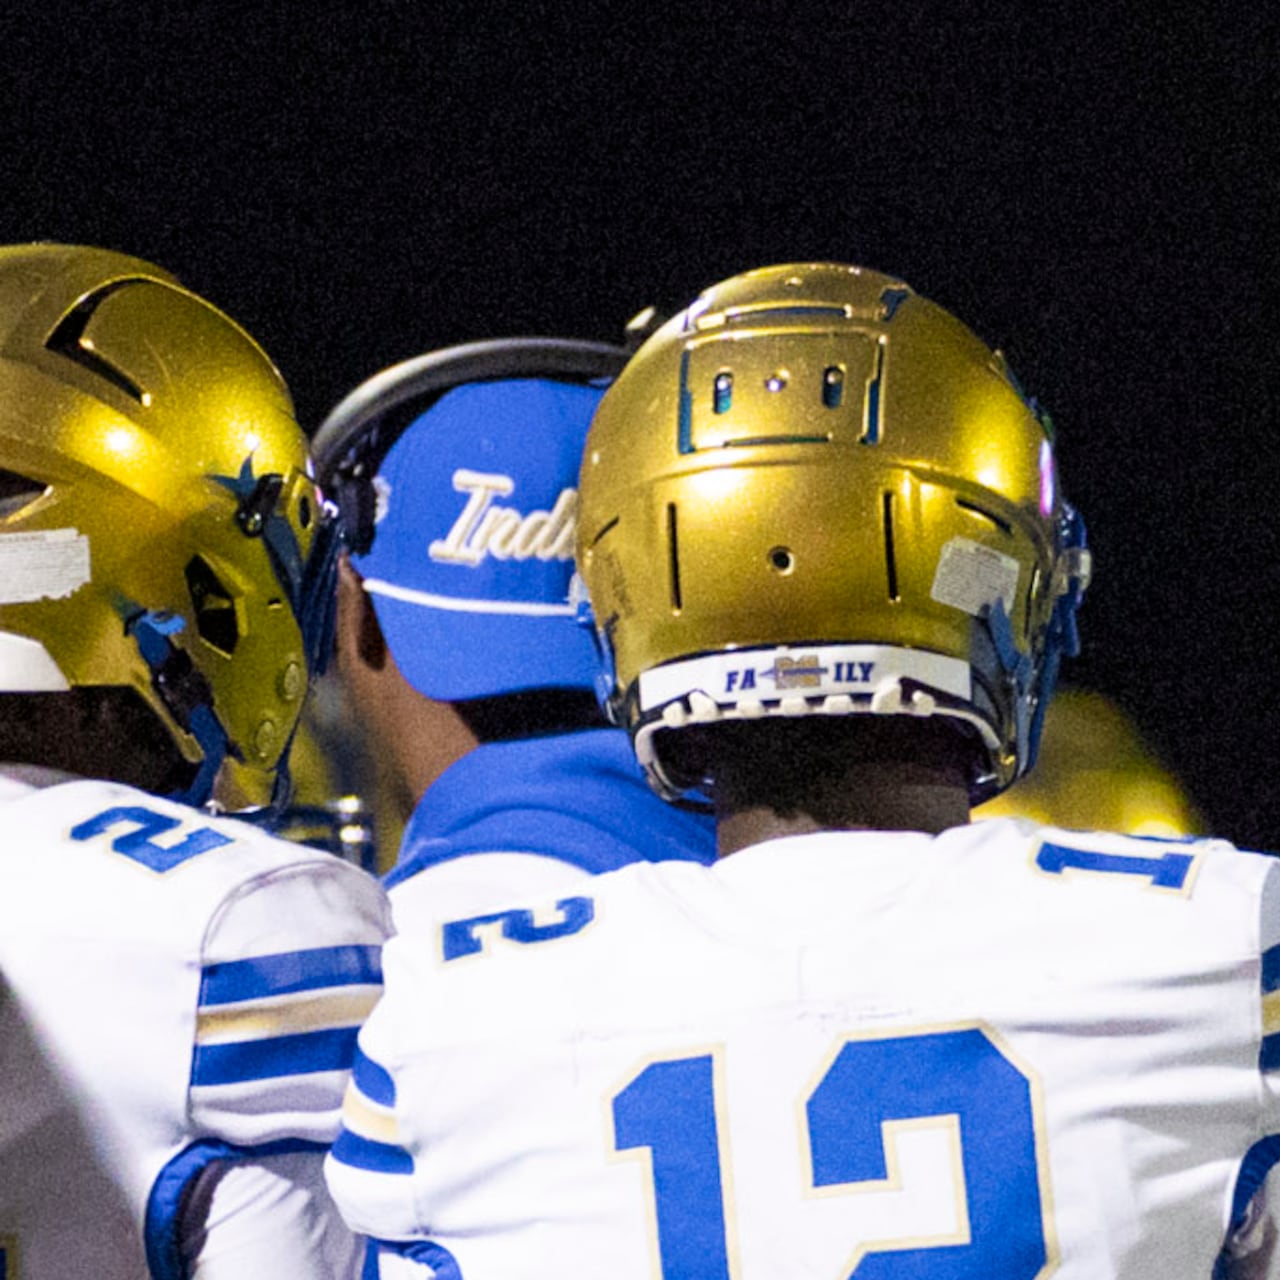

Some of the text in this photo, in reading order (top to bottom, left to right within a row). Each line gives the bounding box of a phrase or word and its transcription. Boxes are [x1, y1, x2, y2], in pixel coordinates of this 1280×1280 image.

[67, 802, 238, 877] 2
[1030, 838, 1204, 899] 1
[437, 892, 599, 964] 2
